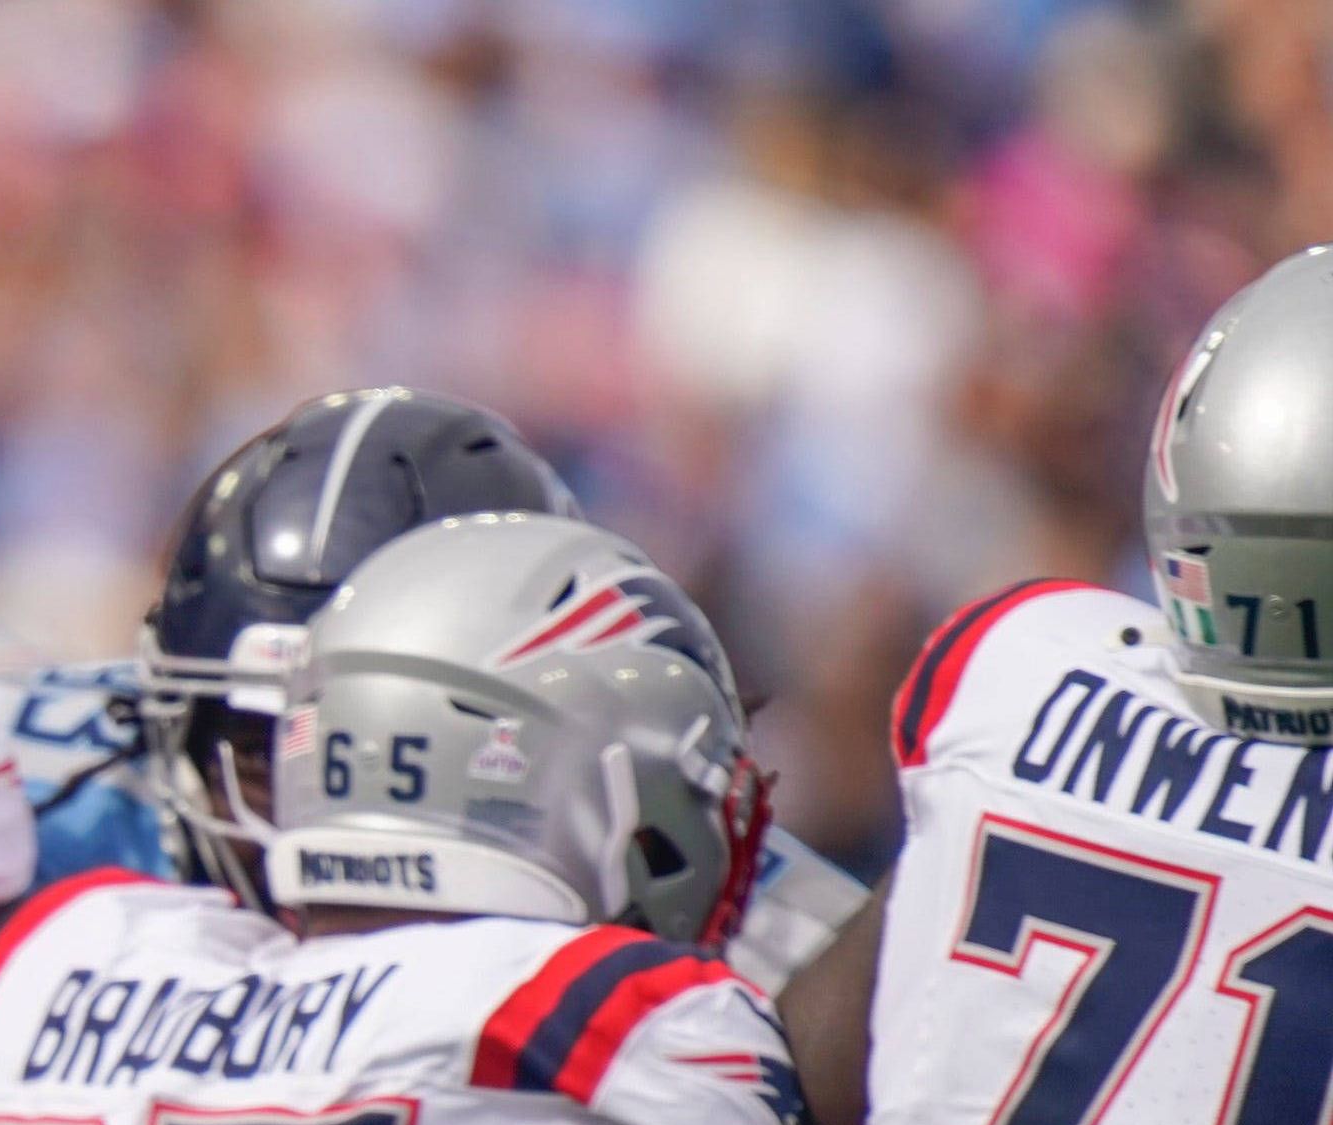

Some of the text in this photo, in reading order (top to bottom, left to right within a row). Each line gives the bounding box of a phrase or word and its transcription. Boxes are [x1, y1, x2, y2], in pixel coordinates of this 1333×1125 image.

[1225, 594, 1321, 660] 71
[1221, 694, 1333, 738] PATRIO
[323, 731, 430, 803] 65
[1013, 668, 1333, 864] ONWEN
